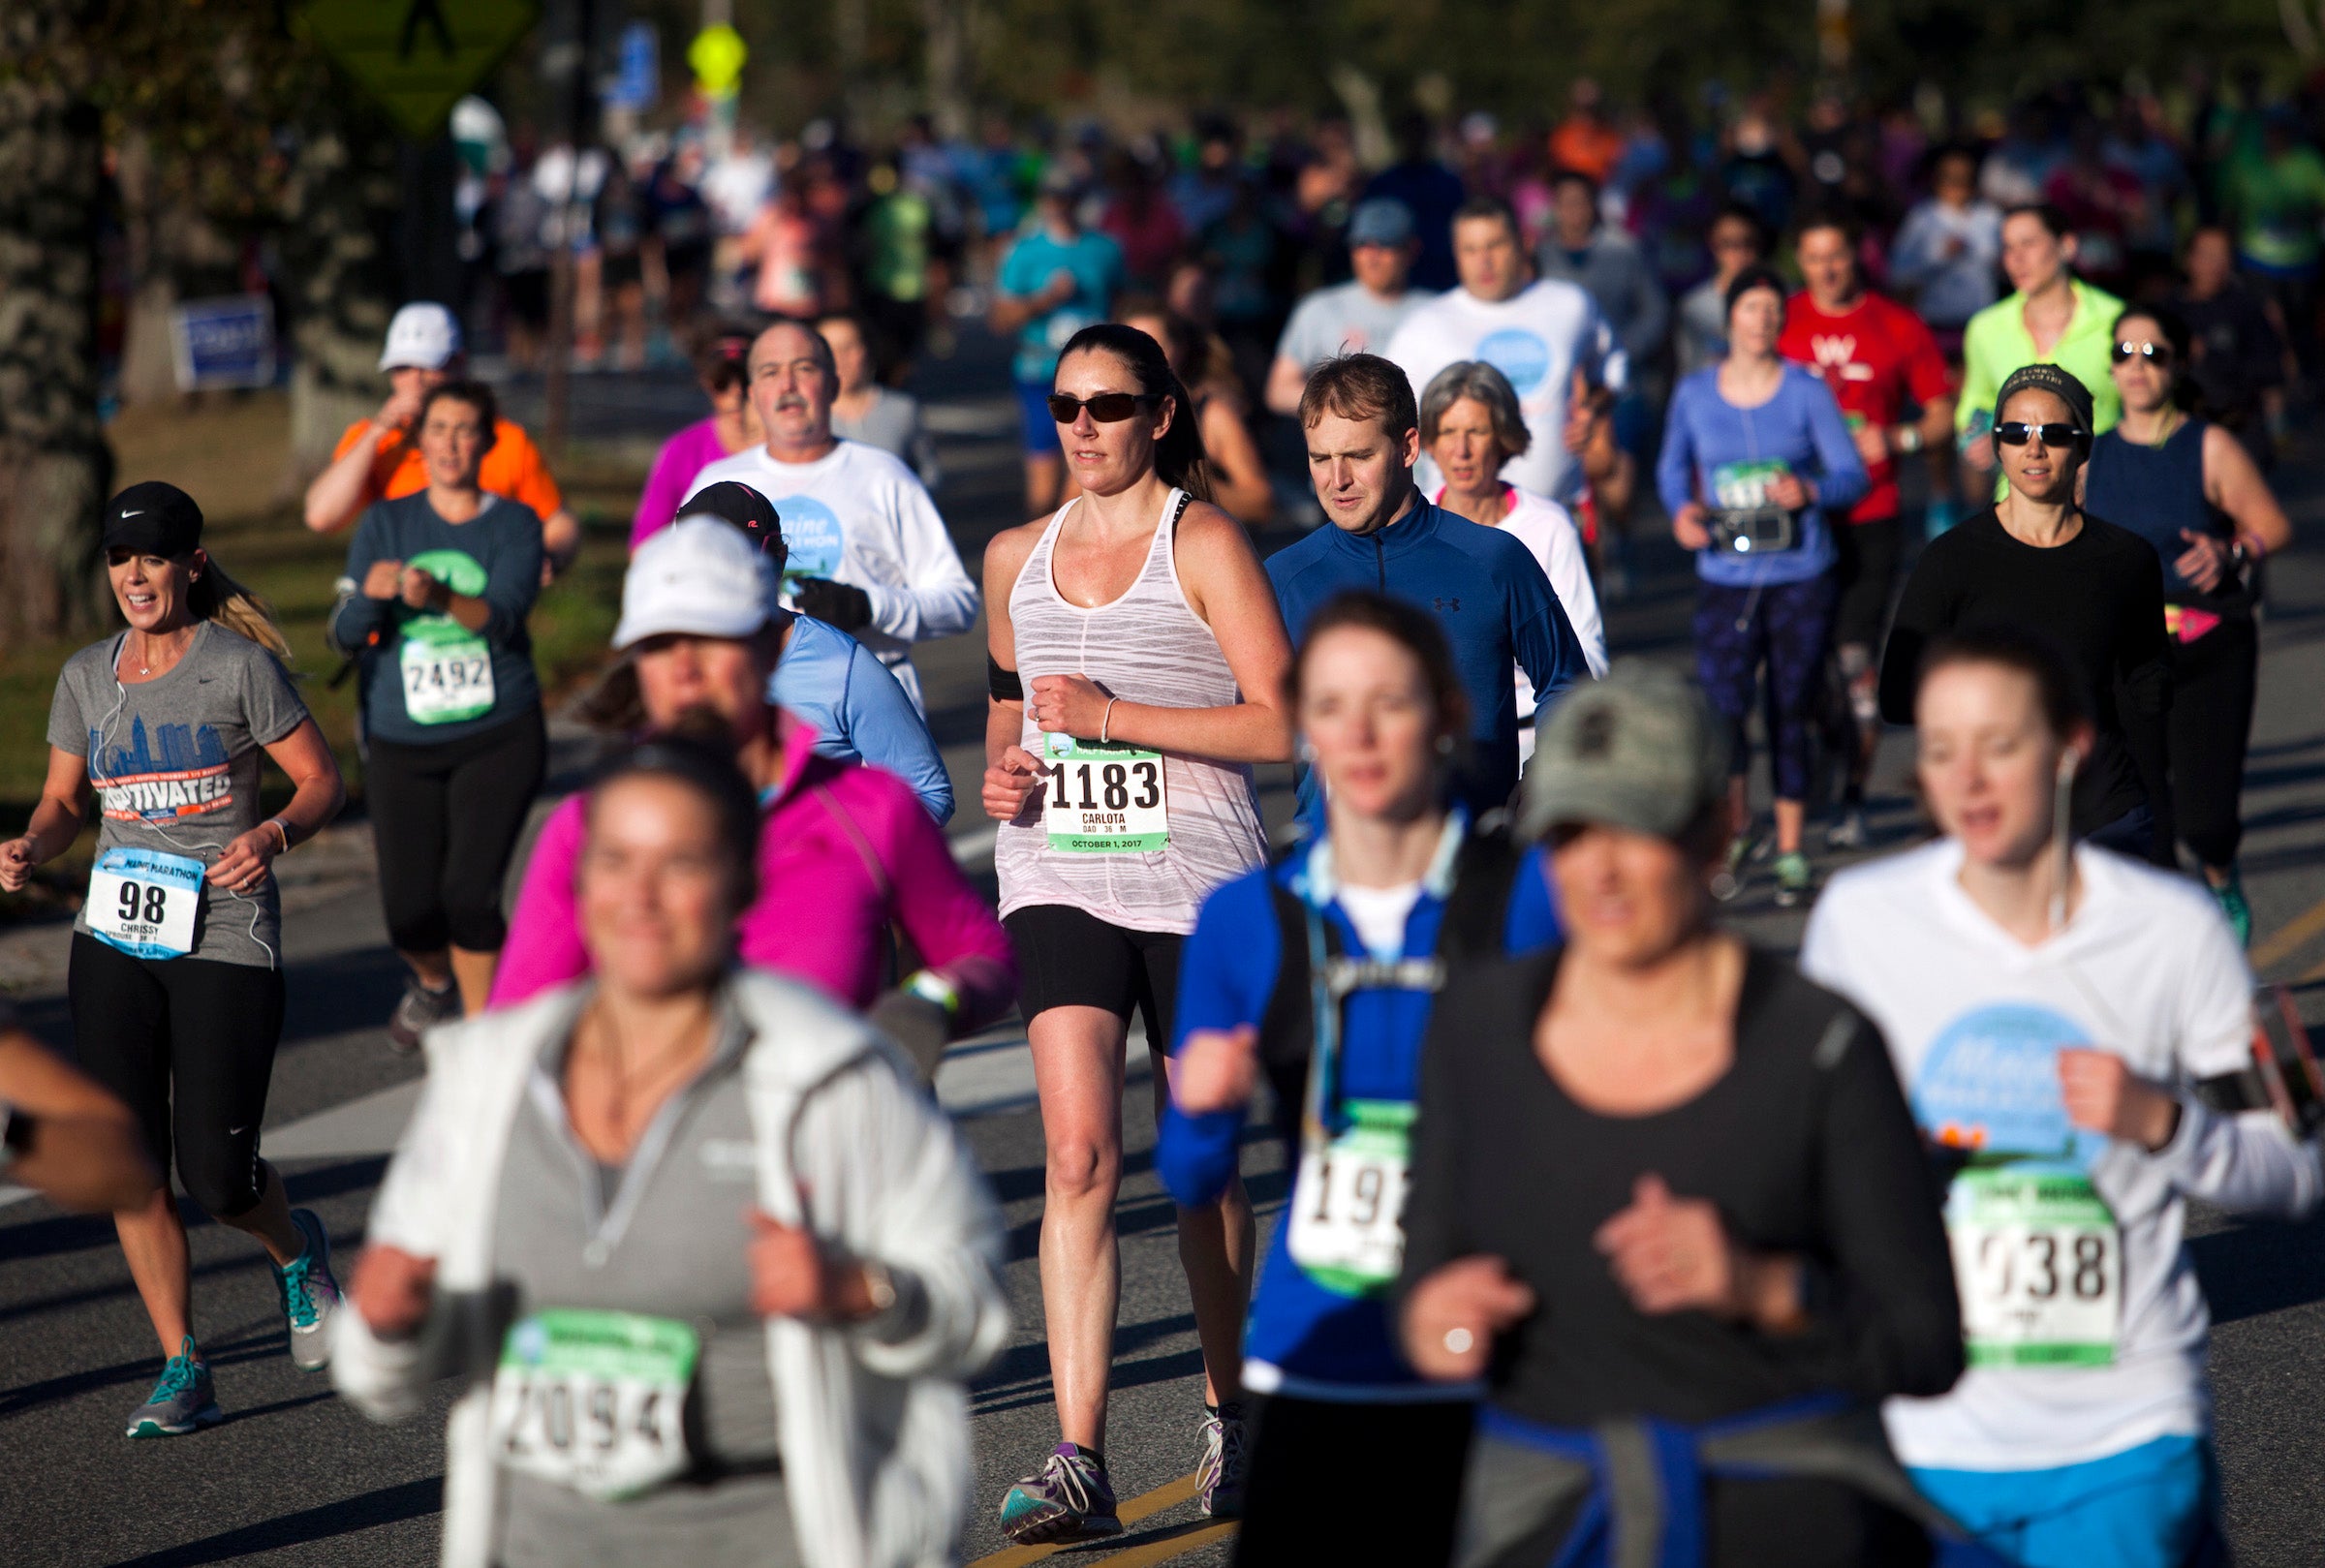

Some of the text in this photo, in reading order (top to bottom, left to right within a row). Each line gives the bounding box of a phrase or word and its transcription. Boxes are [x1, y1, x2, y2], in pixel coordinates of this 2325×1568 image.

[783, 513, 829, 535] aine
[409, 659, 485, 693] 2492
[1050, 761, 1161, 811] 1183
[1082, 813, 1126, 824] CARLOTA
[1119, 824, 1127, 833] M
[1071, 840, 1142, 848] OCTOBER 1, 2017
[124, 858, 200, 883] MAINE MARATHON
[118, 880, 167, 924] 98
[120, 923, 160, 937] CHRISSY
[1313, 1162, 1411, 1228] 19
